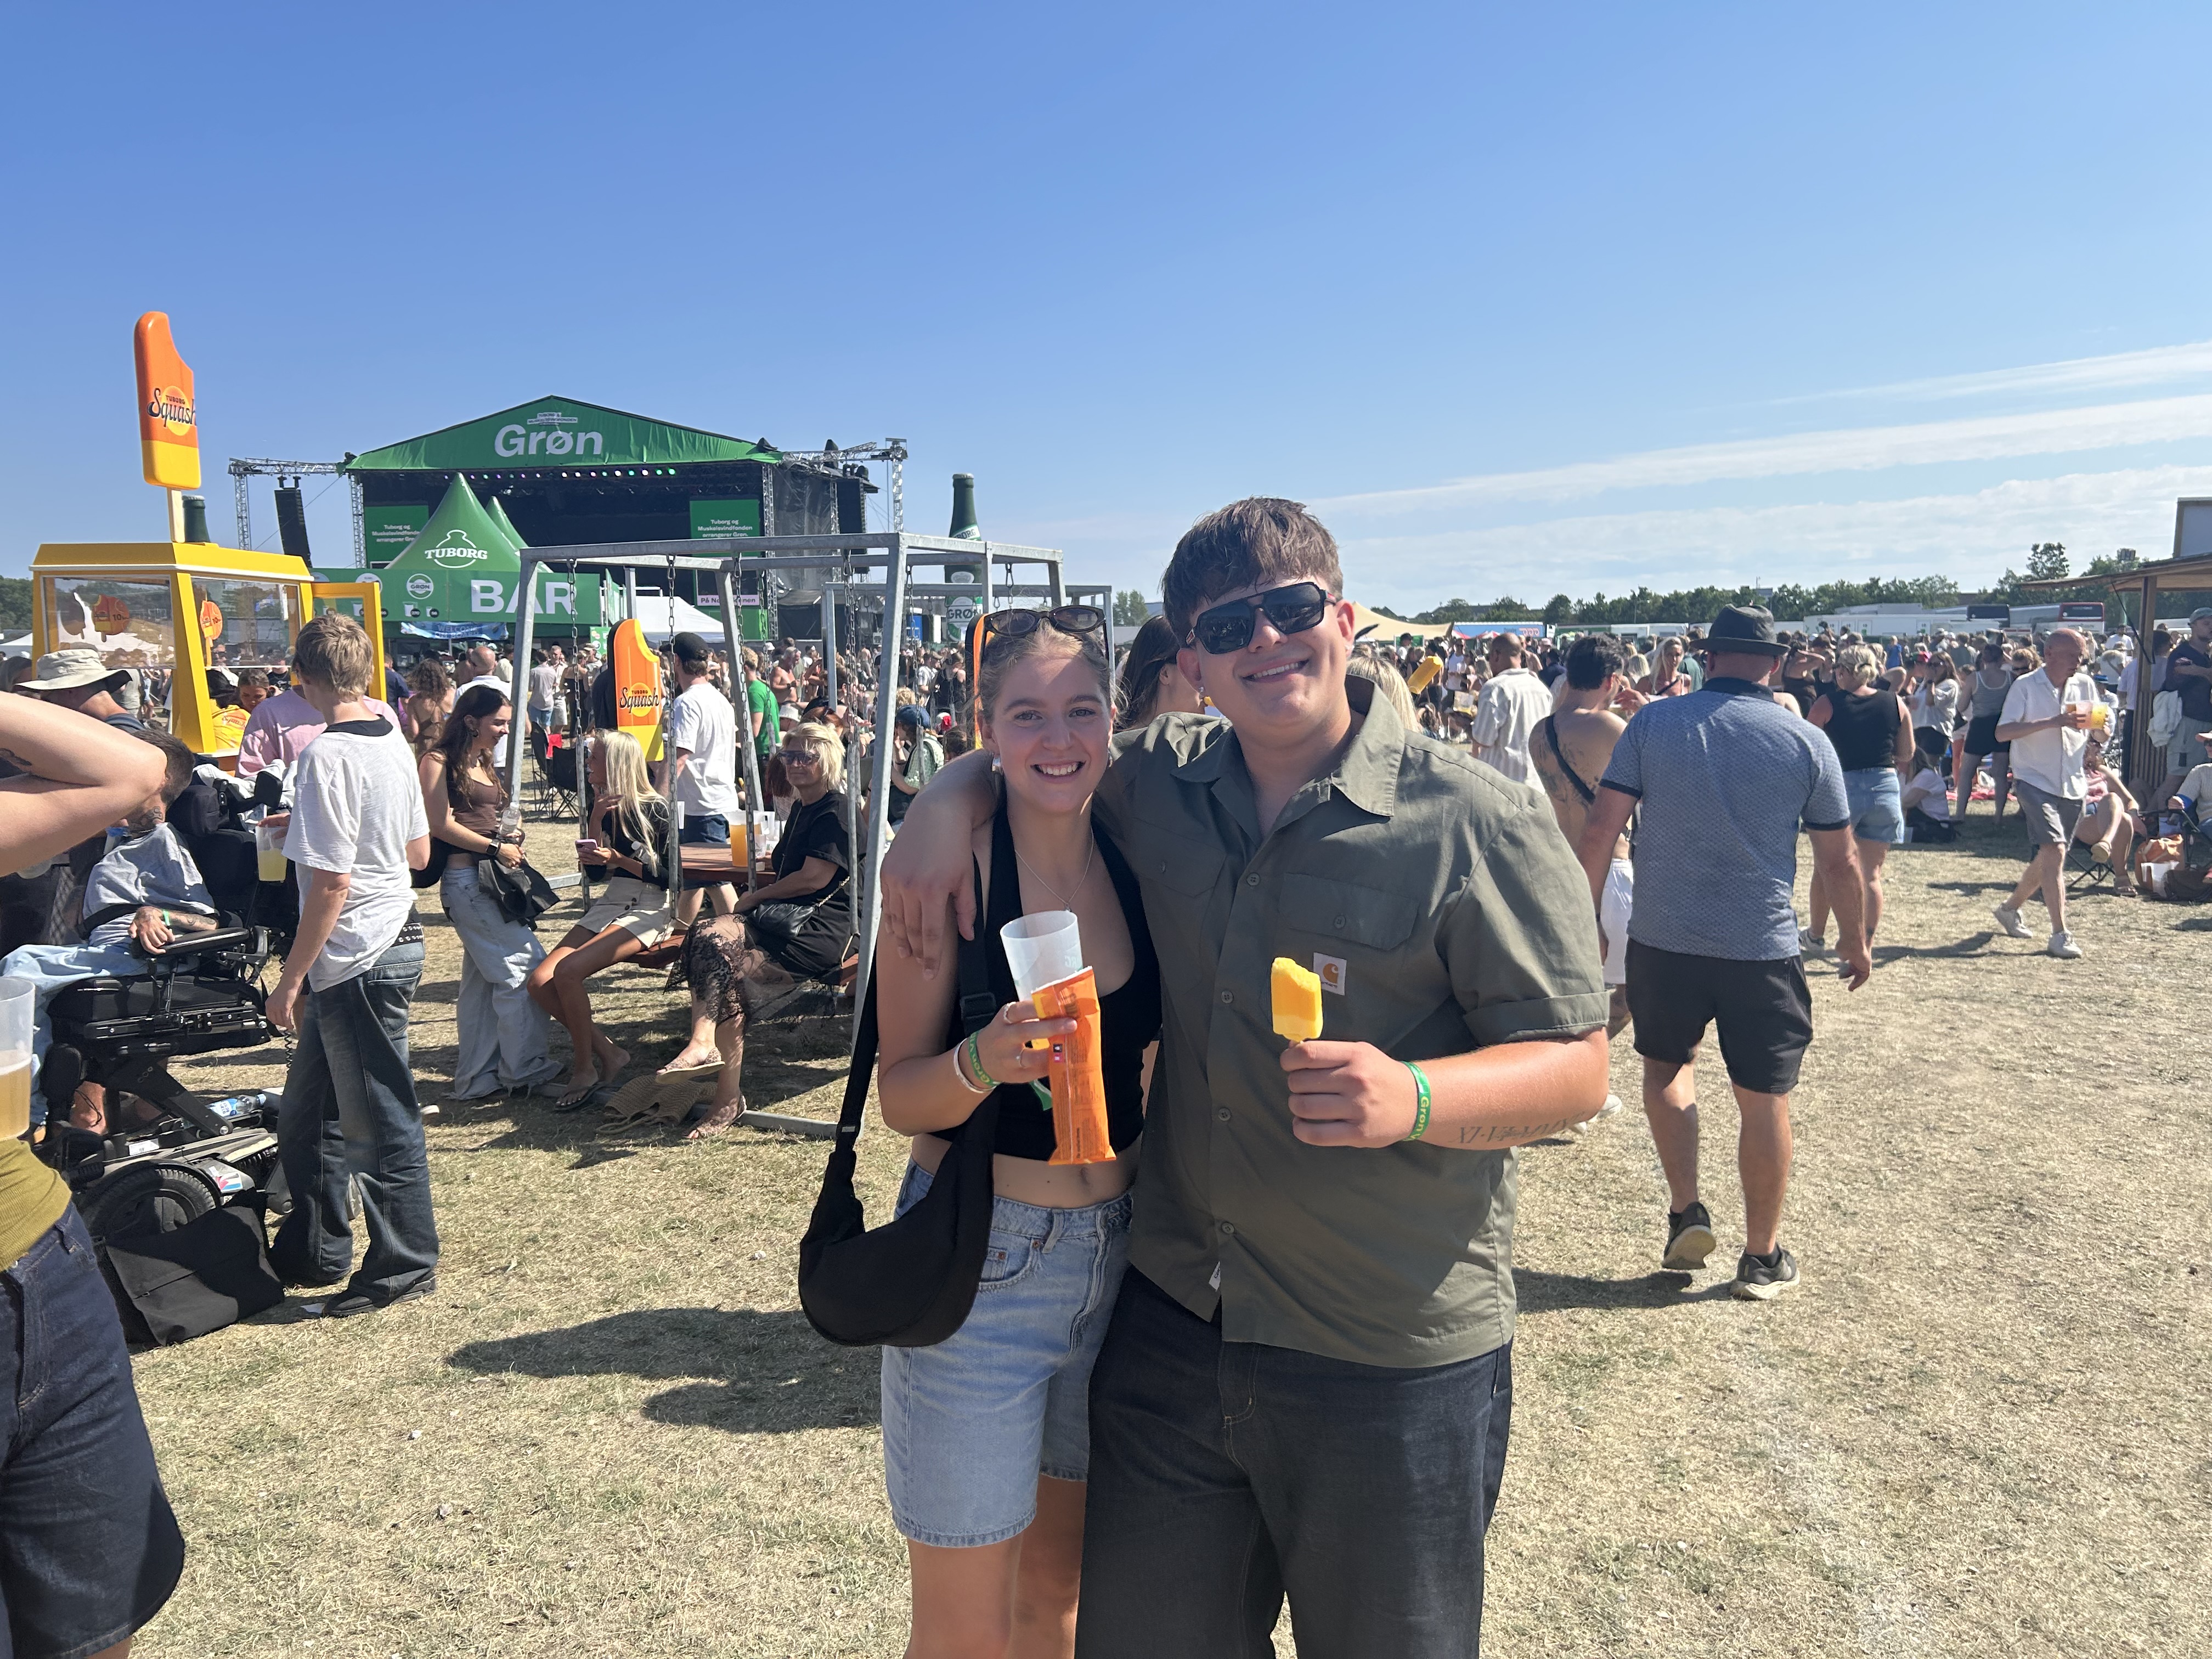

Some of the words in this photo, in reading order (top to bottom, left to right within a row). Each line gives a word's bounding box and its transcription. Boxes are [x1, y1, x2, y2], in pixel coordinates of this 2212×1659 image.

[147, 387, 196, 427] Squash
[495, 424, 602, 458] Grøn
[955, 528, 976, 539] BORG
[425, 548, 488, 560] TUBORG
[947, 608, 981, 619] GRØN
[619, 687, 660, 714] Squash
